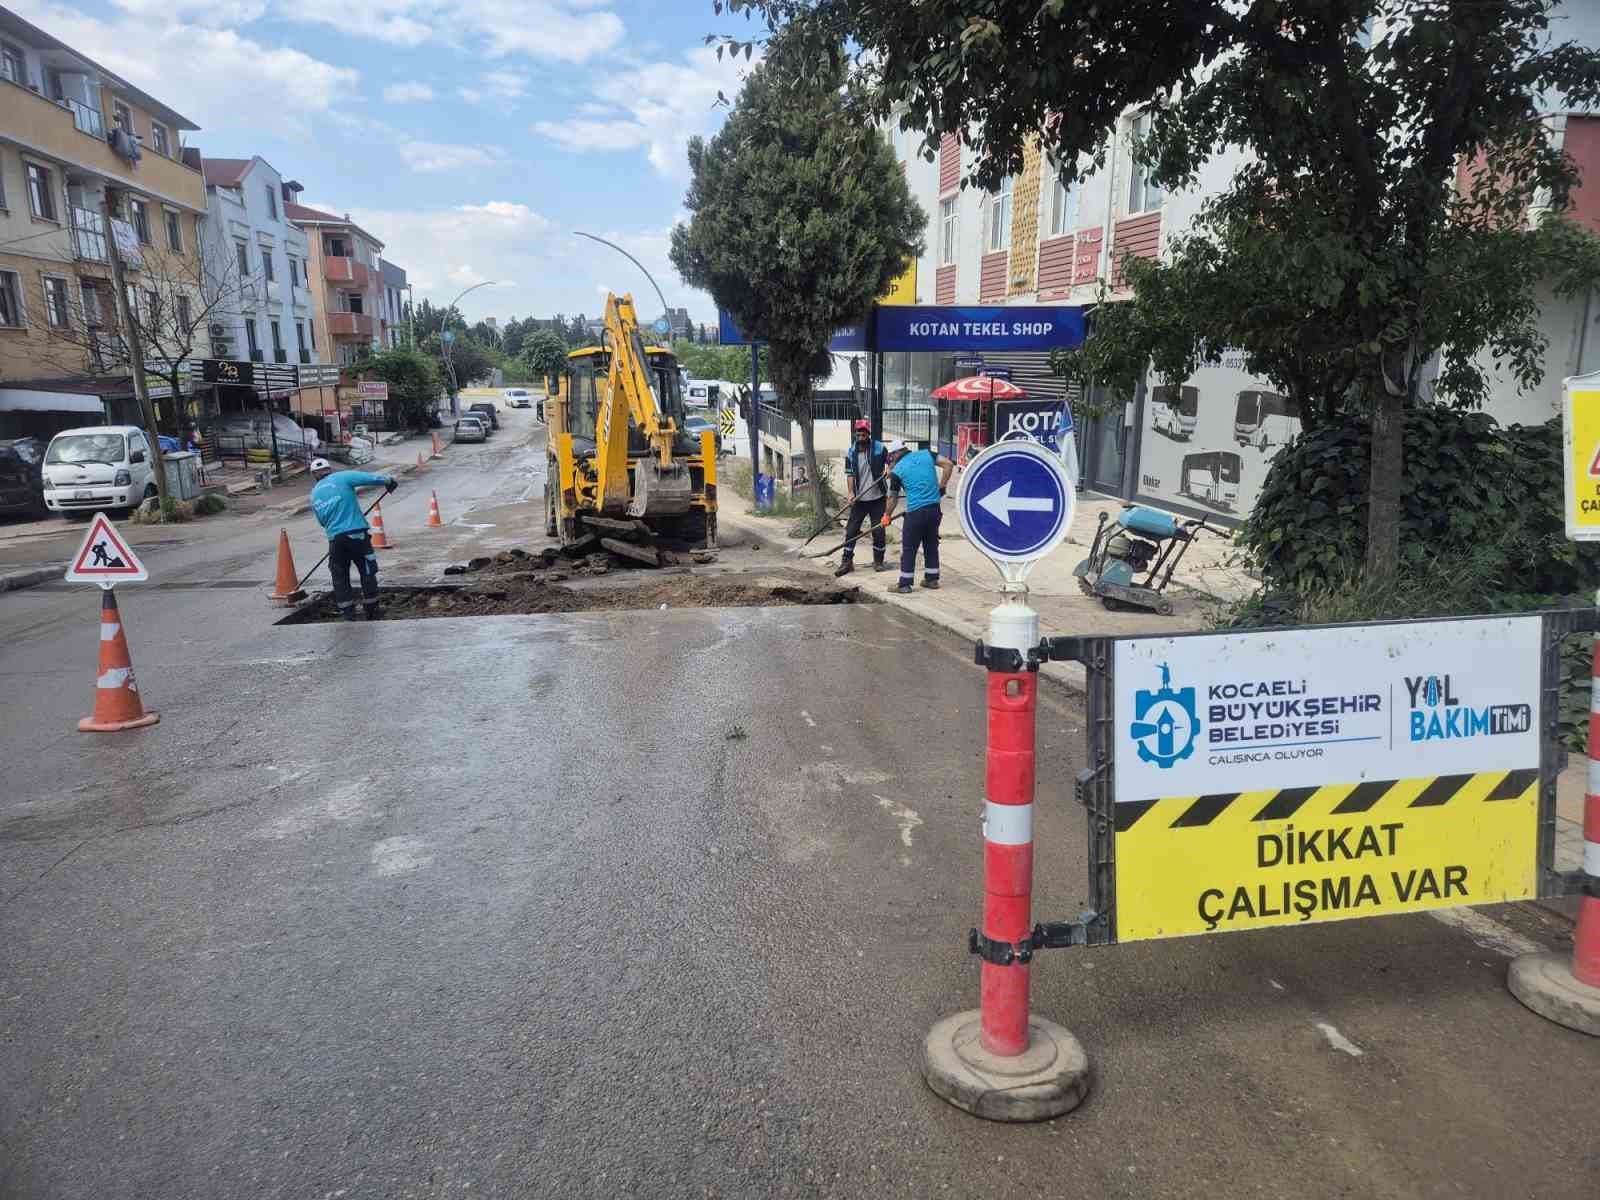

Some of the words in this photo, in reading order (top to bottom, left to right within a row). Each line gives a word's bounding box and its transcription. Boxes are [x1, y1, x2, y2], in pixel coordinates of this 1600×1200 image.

[909, 322, 959, 336] KOTAN
[963, 322, 1009, 336] TEKEL
[1012, 322, 1053, 336] SHOP
[1410, 706, 1489, 741] BAKIM
[1274, 748, 1324, 761] OLUYOR
[1257, 823, 1404, 868] DİKKAT
[1198, 874, 1381, 931] ÇALIŞMA
[1390, 865, 1469, 903] VAR
